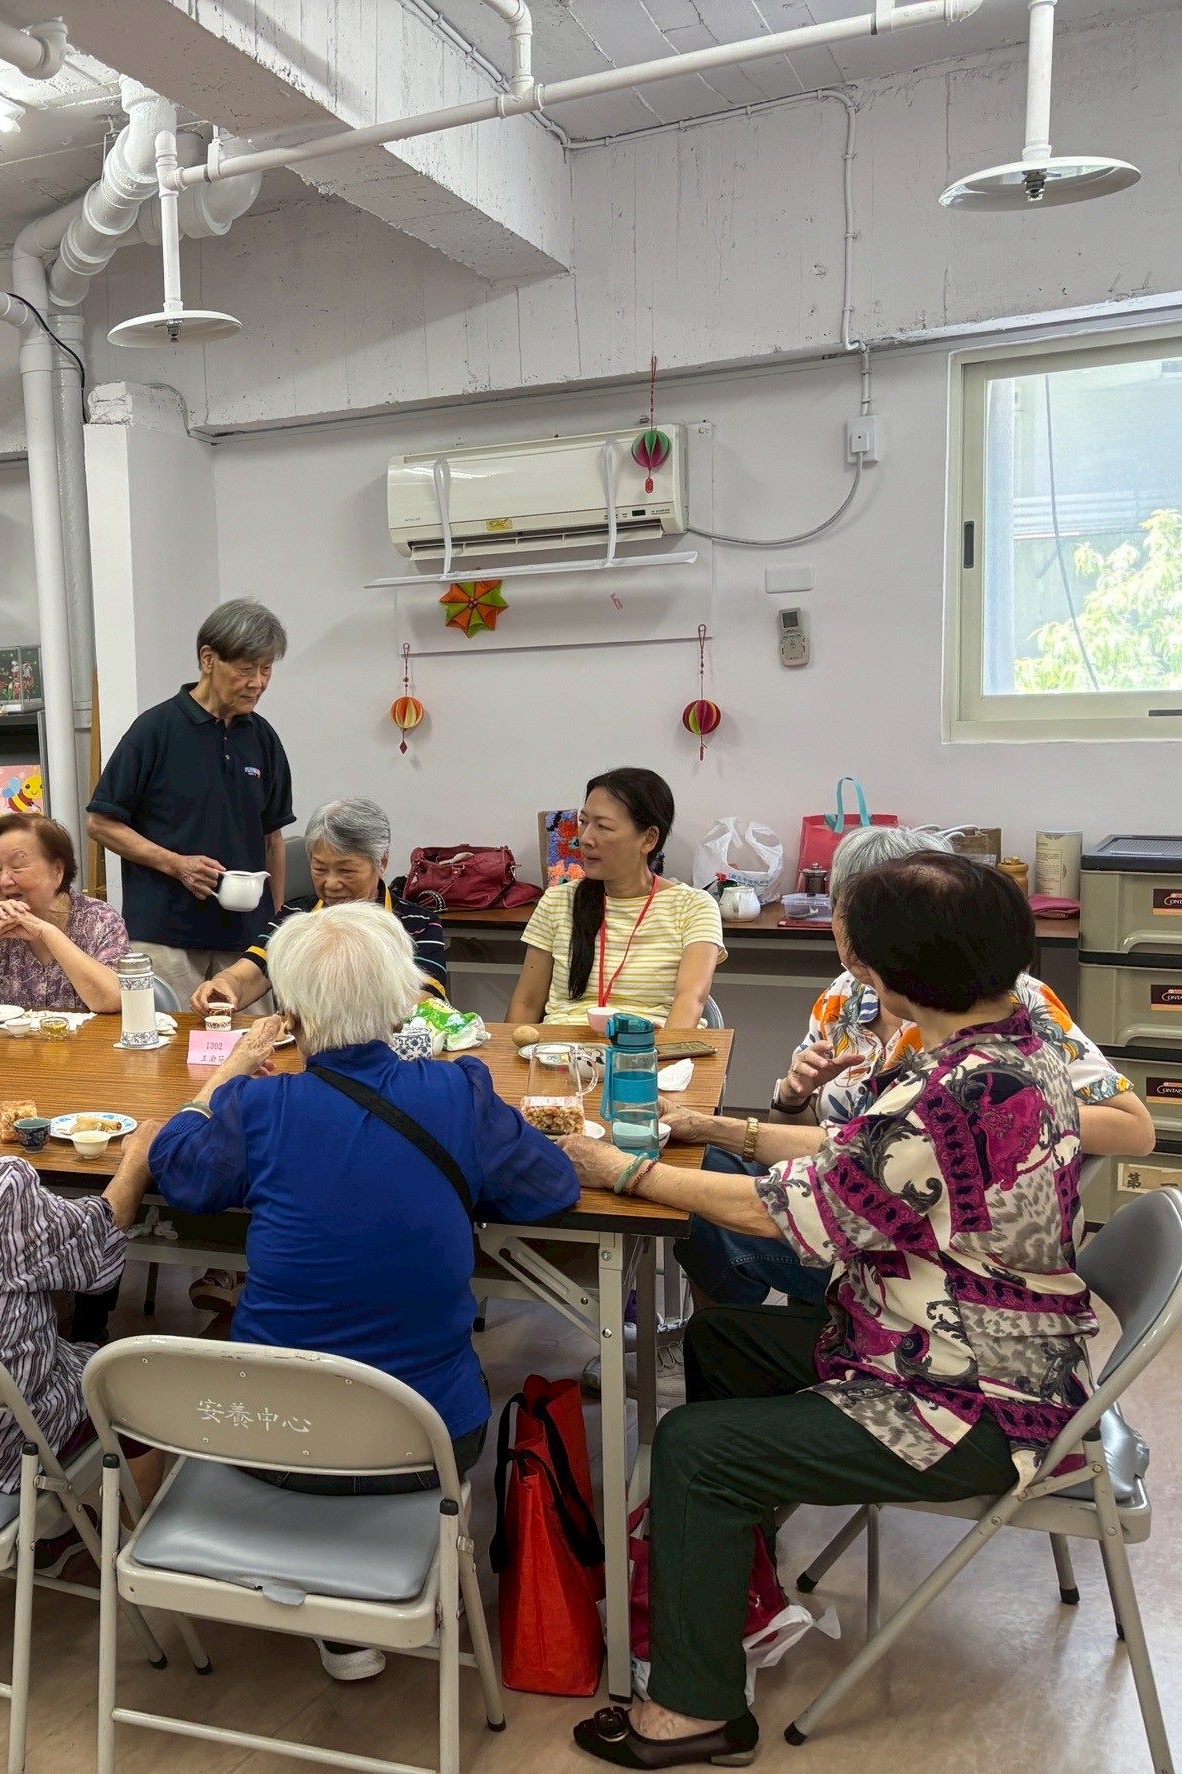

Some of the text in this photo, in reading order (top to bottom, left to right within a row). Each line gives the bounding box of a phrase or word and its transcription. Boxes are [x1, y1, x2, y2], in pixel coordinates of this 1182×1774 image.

[206, 1041, 223, 1050] 1302
[196, 1398, 312, 1433] 安養中心
